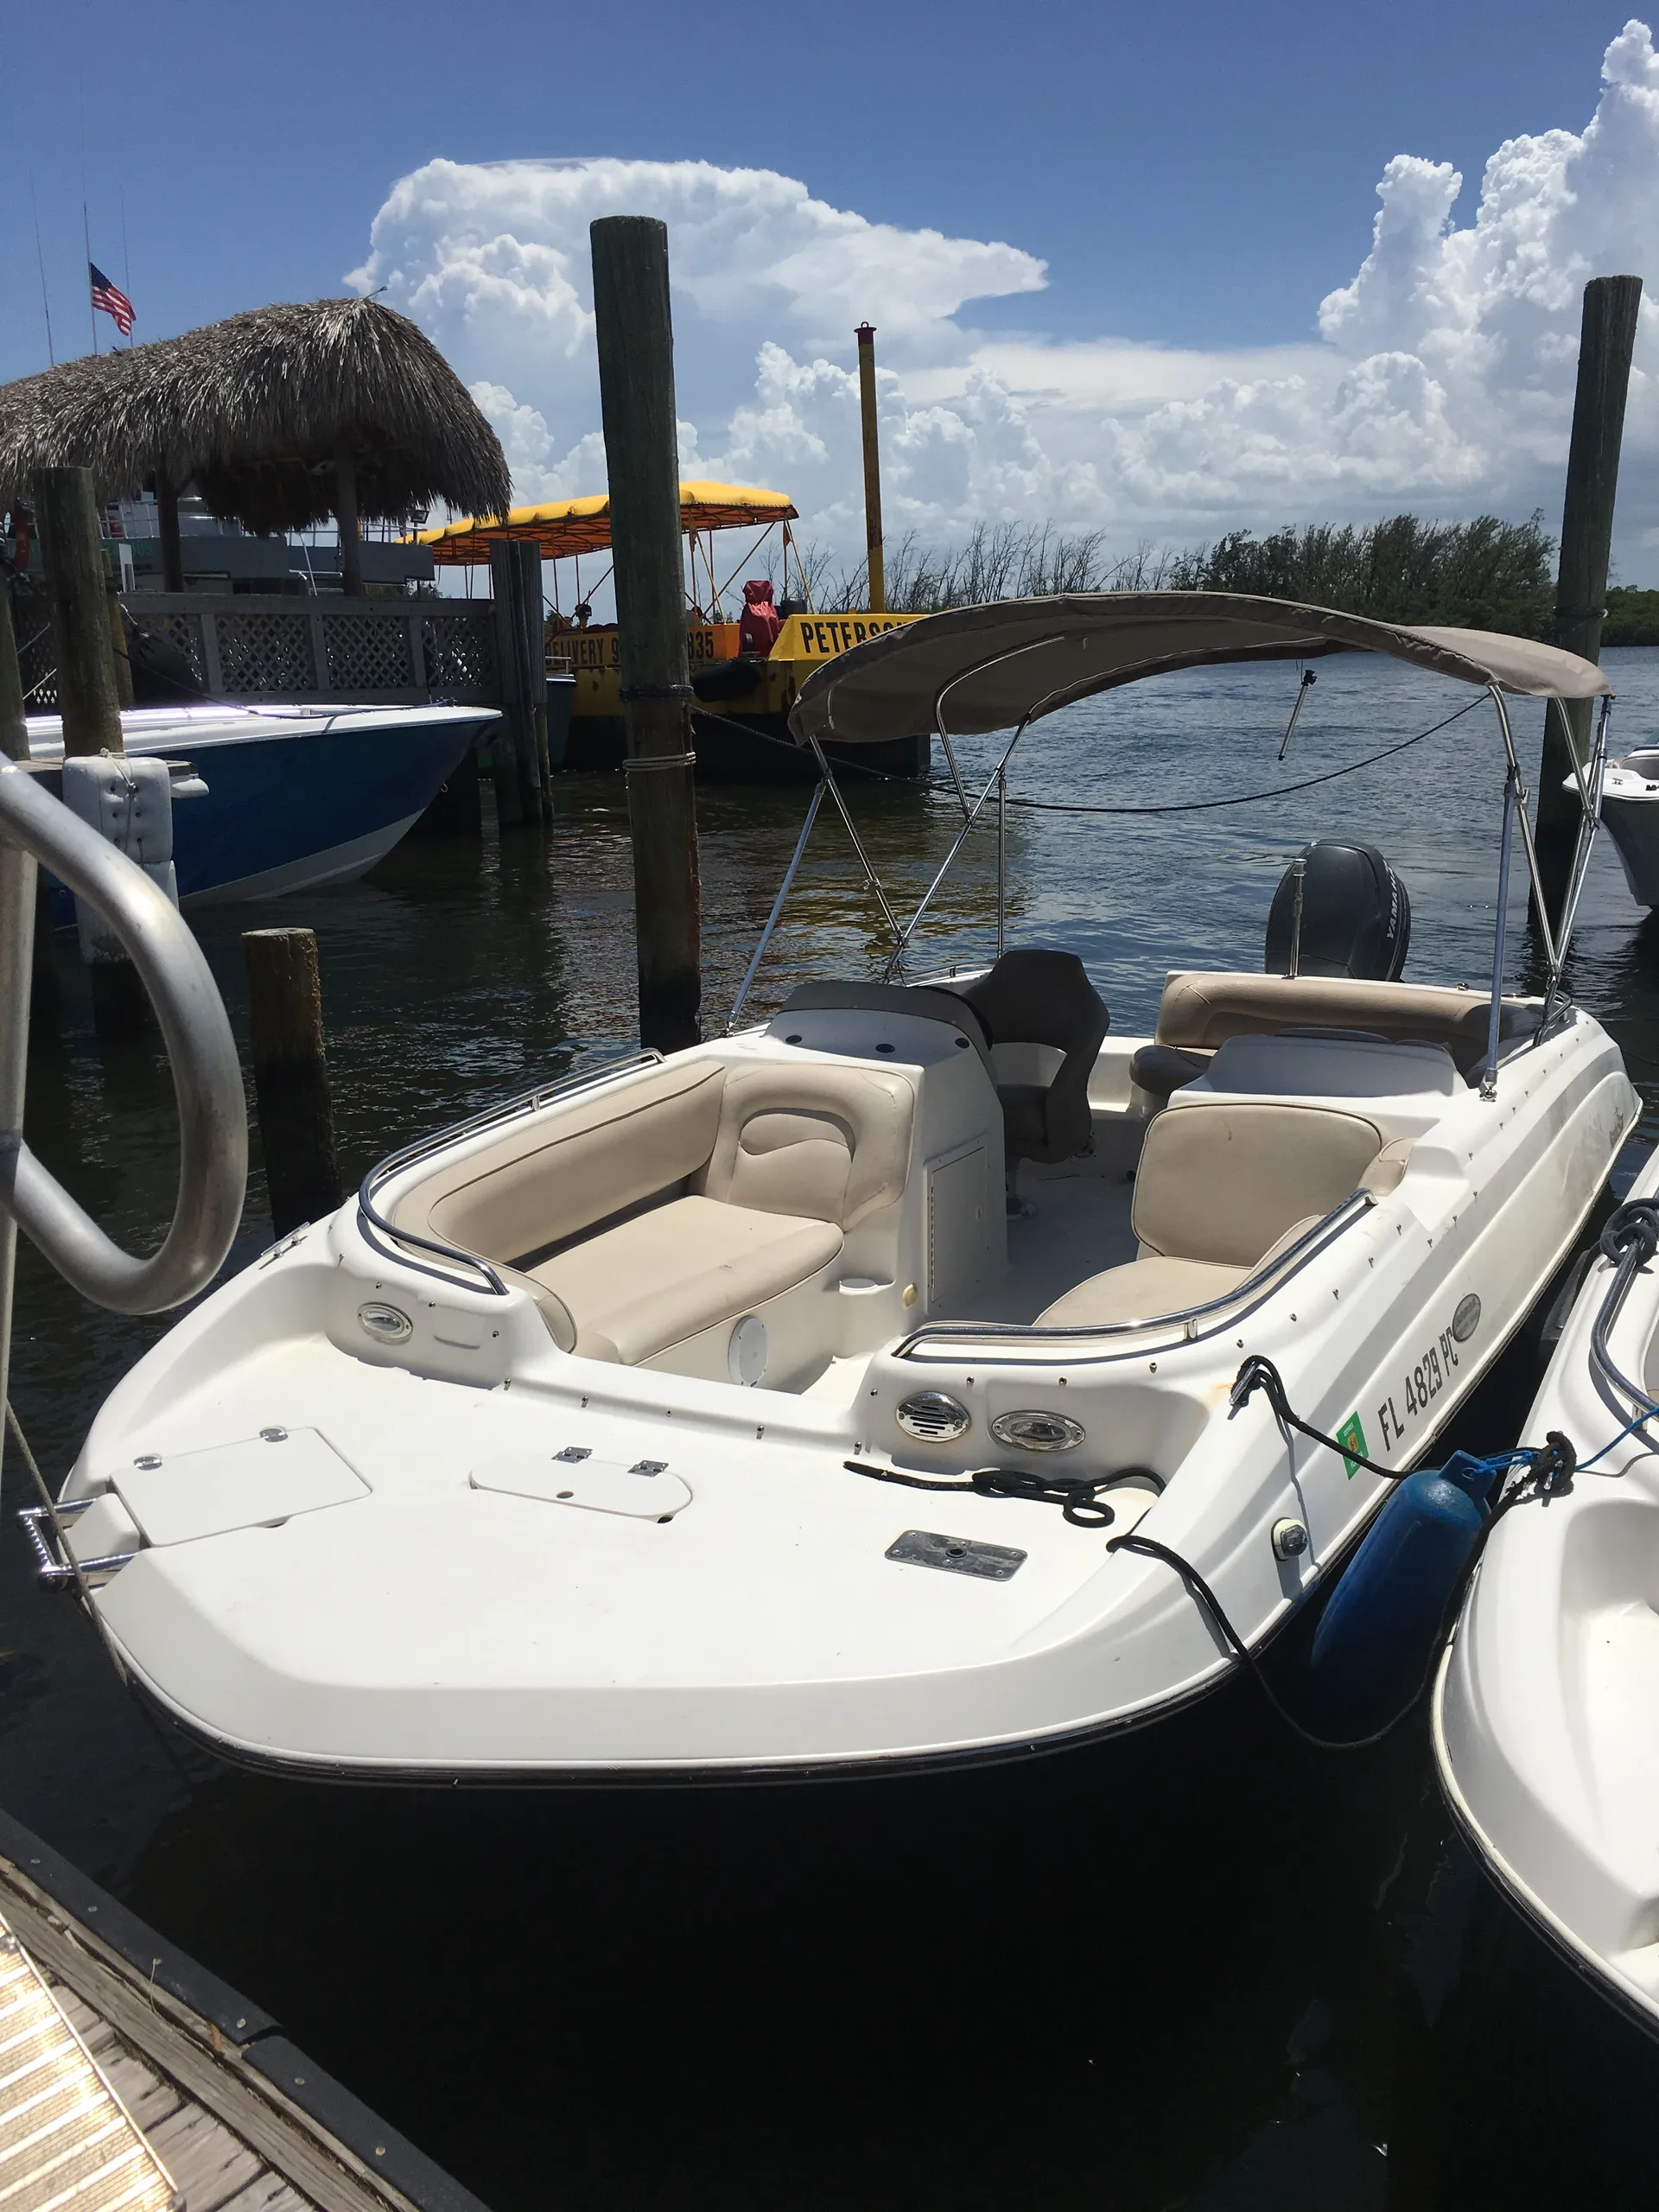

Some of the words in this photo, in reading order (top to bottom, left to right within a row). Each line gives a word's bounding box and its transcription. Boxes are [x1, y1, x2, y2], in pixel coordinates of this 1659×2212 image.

[800, 622, 908, 653] PETER
[1378, 1397, 1404, 1452] FL
[1405, 1346, 1443, 1416] 4829
